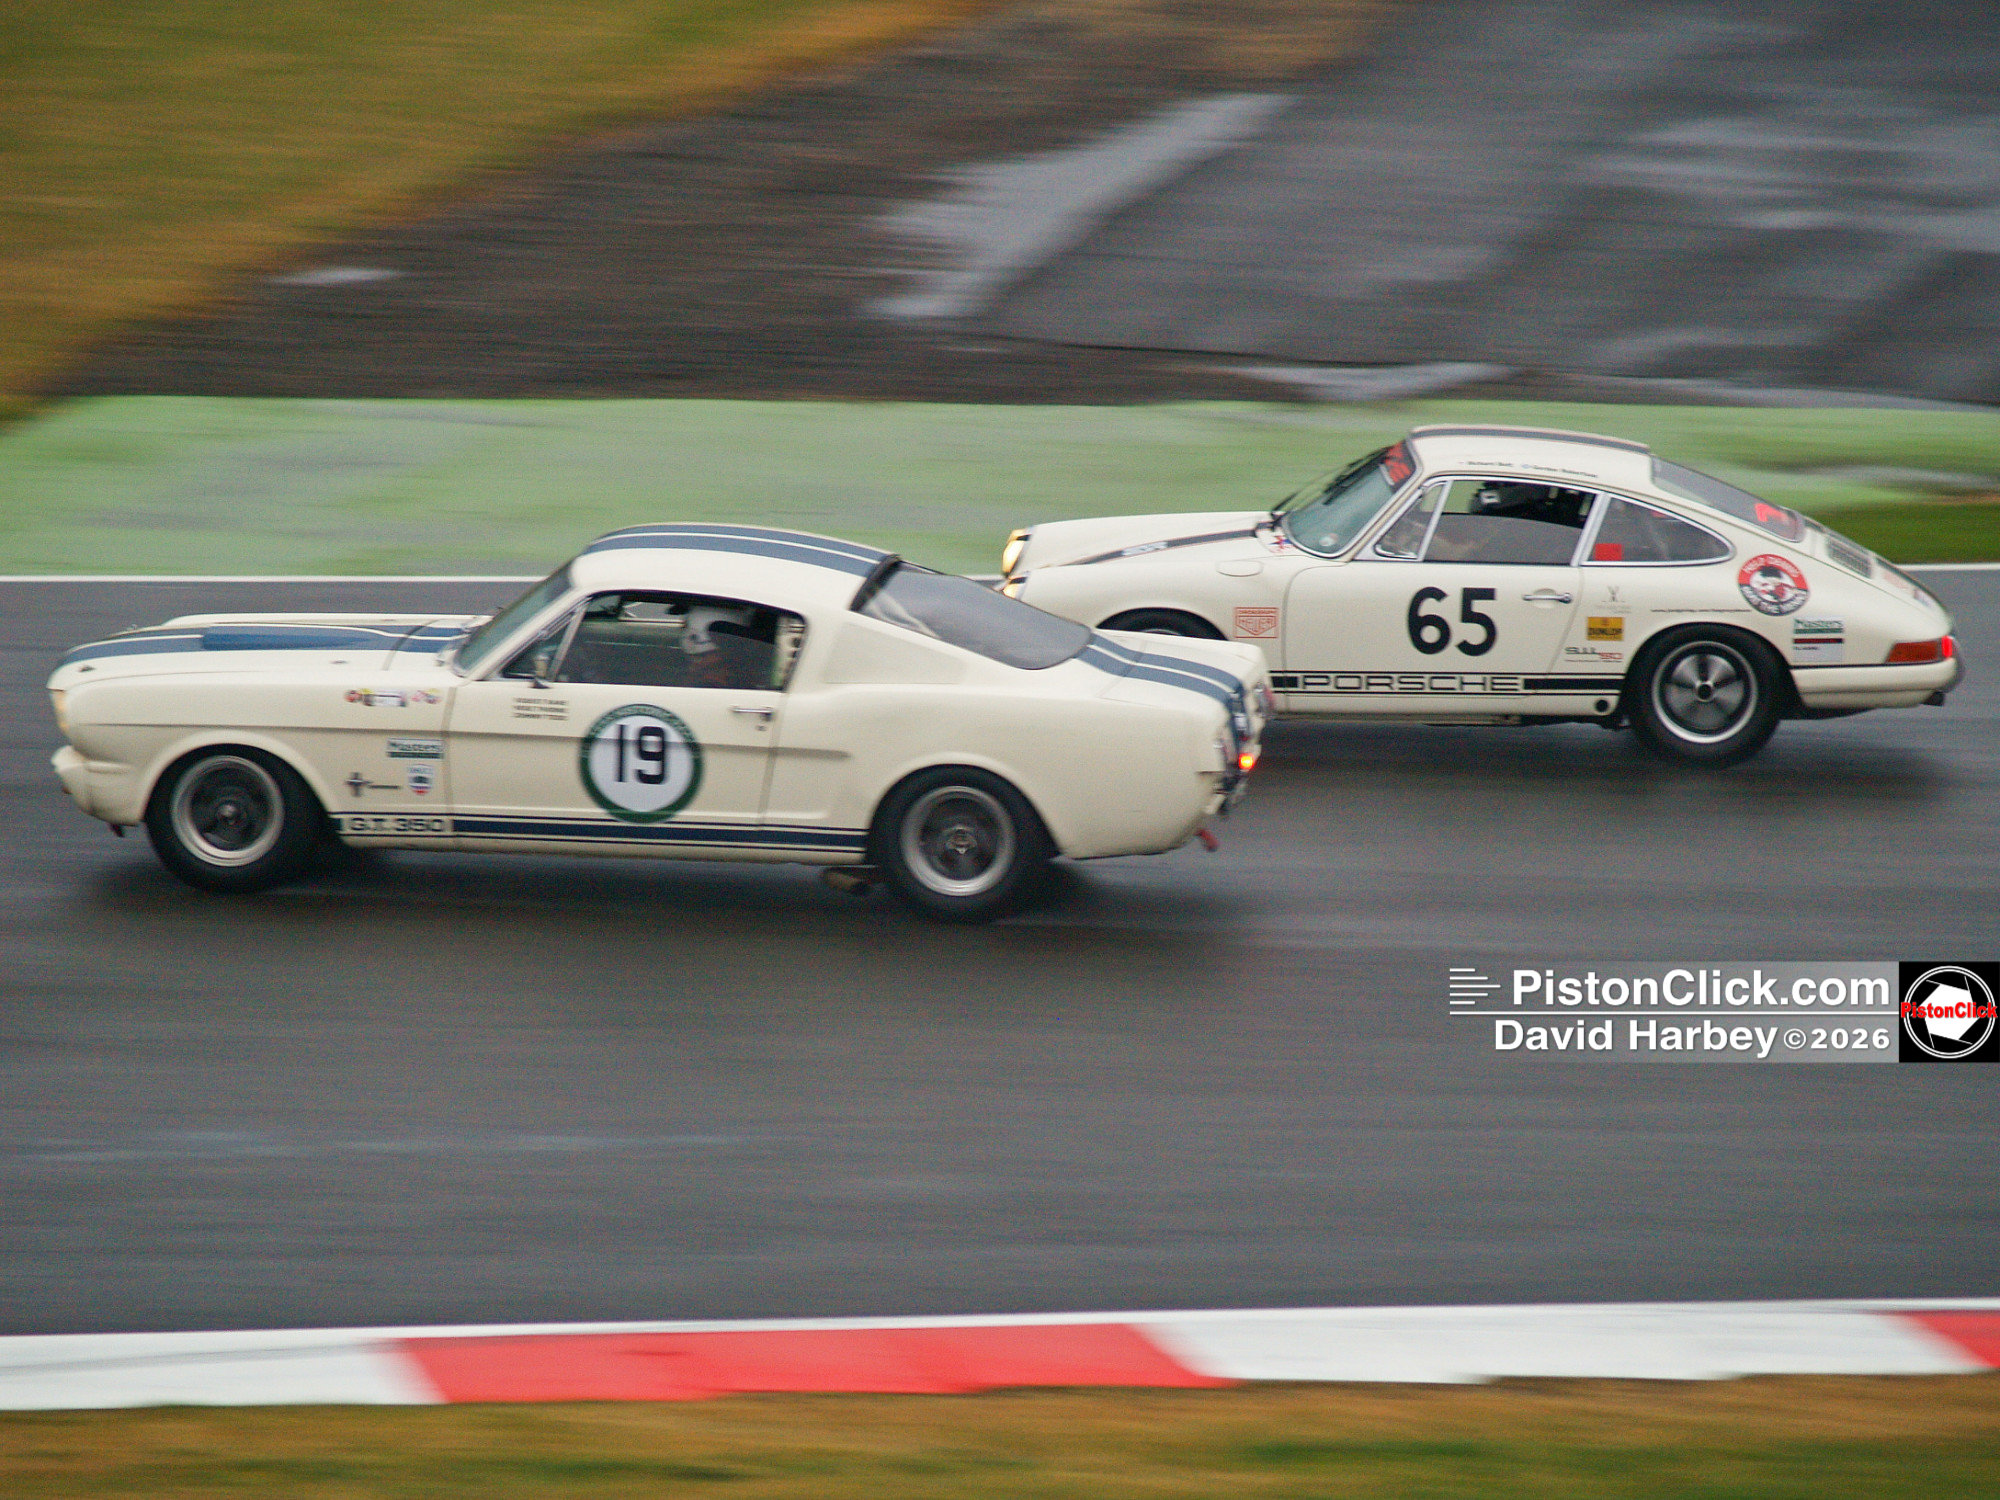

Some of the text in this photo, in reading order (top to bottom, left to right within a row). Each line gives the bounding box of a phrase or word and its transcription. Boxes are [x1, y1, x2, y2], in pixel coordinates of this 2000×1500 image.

[1408, 586, 1498, 657] 65
[1302, 674, 1520, 692] PORSCHE
[616, 723, 667, 786] 19
[395, 817, 445, 833] 350
